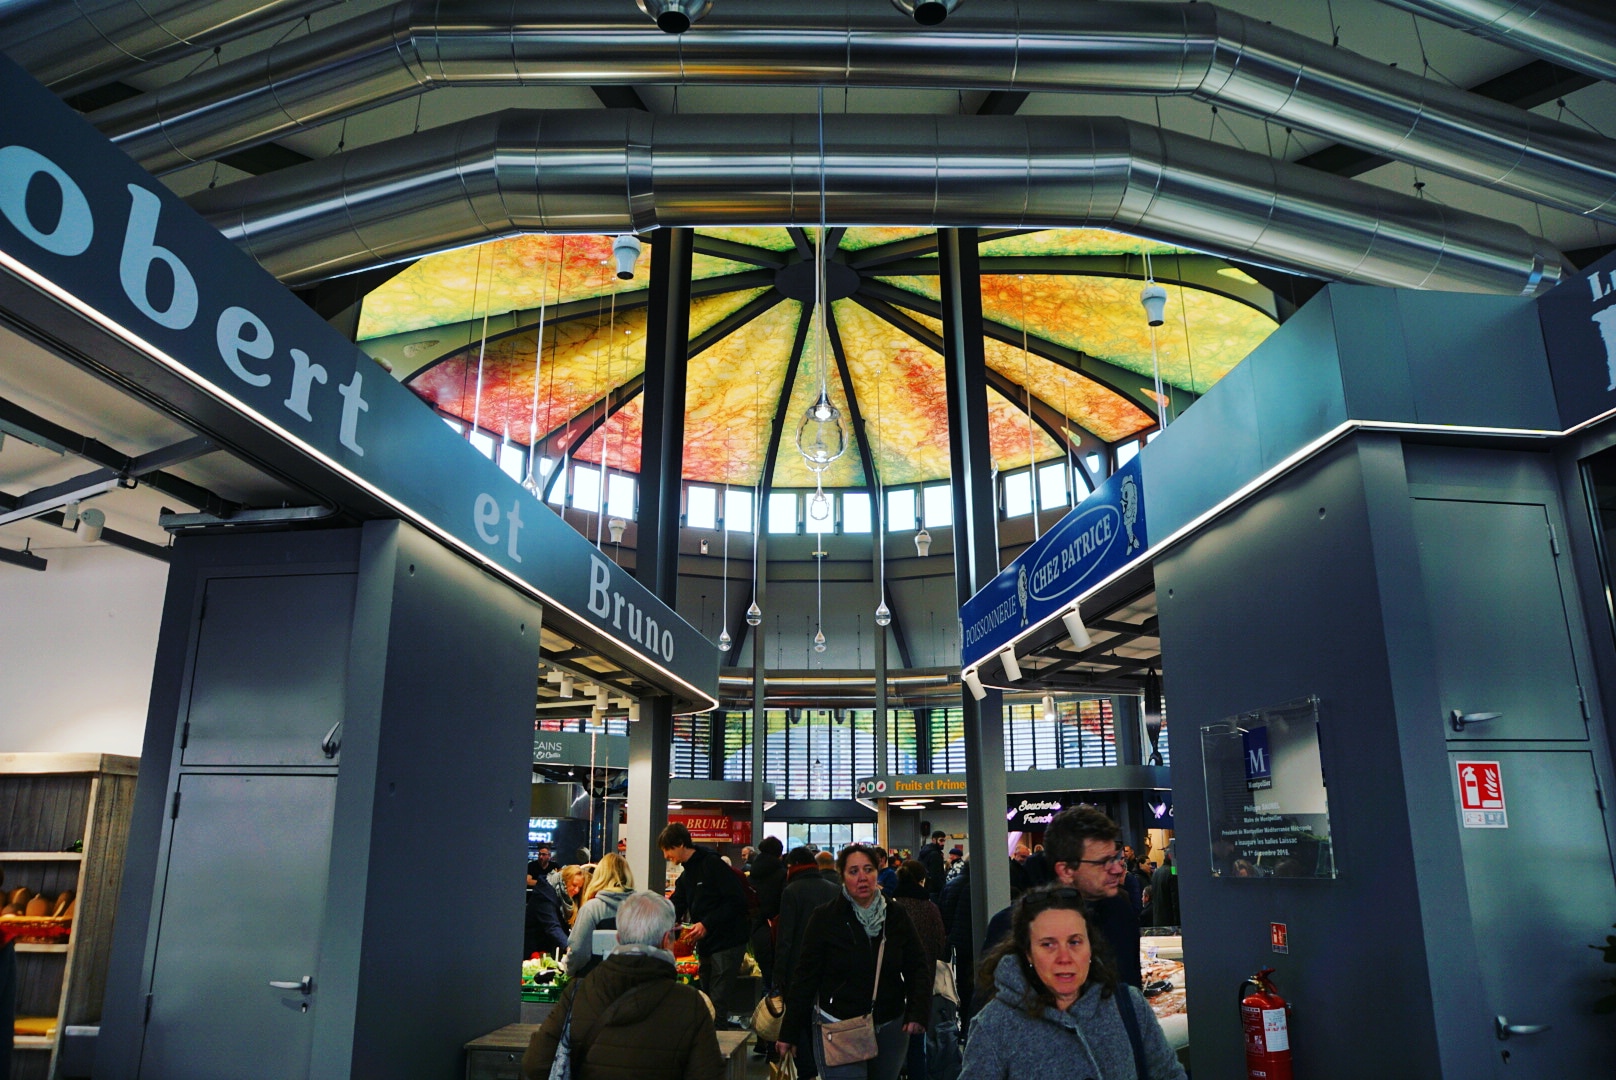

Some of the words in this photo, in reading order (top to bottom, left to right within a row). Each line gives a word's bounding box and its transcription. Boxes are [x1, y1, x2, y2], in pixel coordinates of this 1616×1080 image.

[0, 145, 369, 457] obert
[473, 492, 524, 564] et
[587, 553, 674, 663] Bruno
[1033, 560, 1060, 595] CHEZ
[1061, 514, 1112, 573] PATRICE
[965, 594, 1017, 648] POISSONNERIE
[1248, 748, 1266, 774] M
[895, 779, 922, 790] Fruits
[924, 780, 934, 790] et
[937, 778, 966, 789] Prime
[1248, 780, 1270, 788] Montpellier
[1018, 799, 1061, 811] Boucherie
[686, 816, 729, 829] BRUMÉ
[1279, 837, 1298, 845] Laissac
